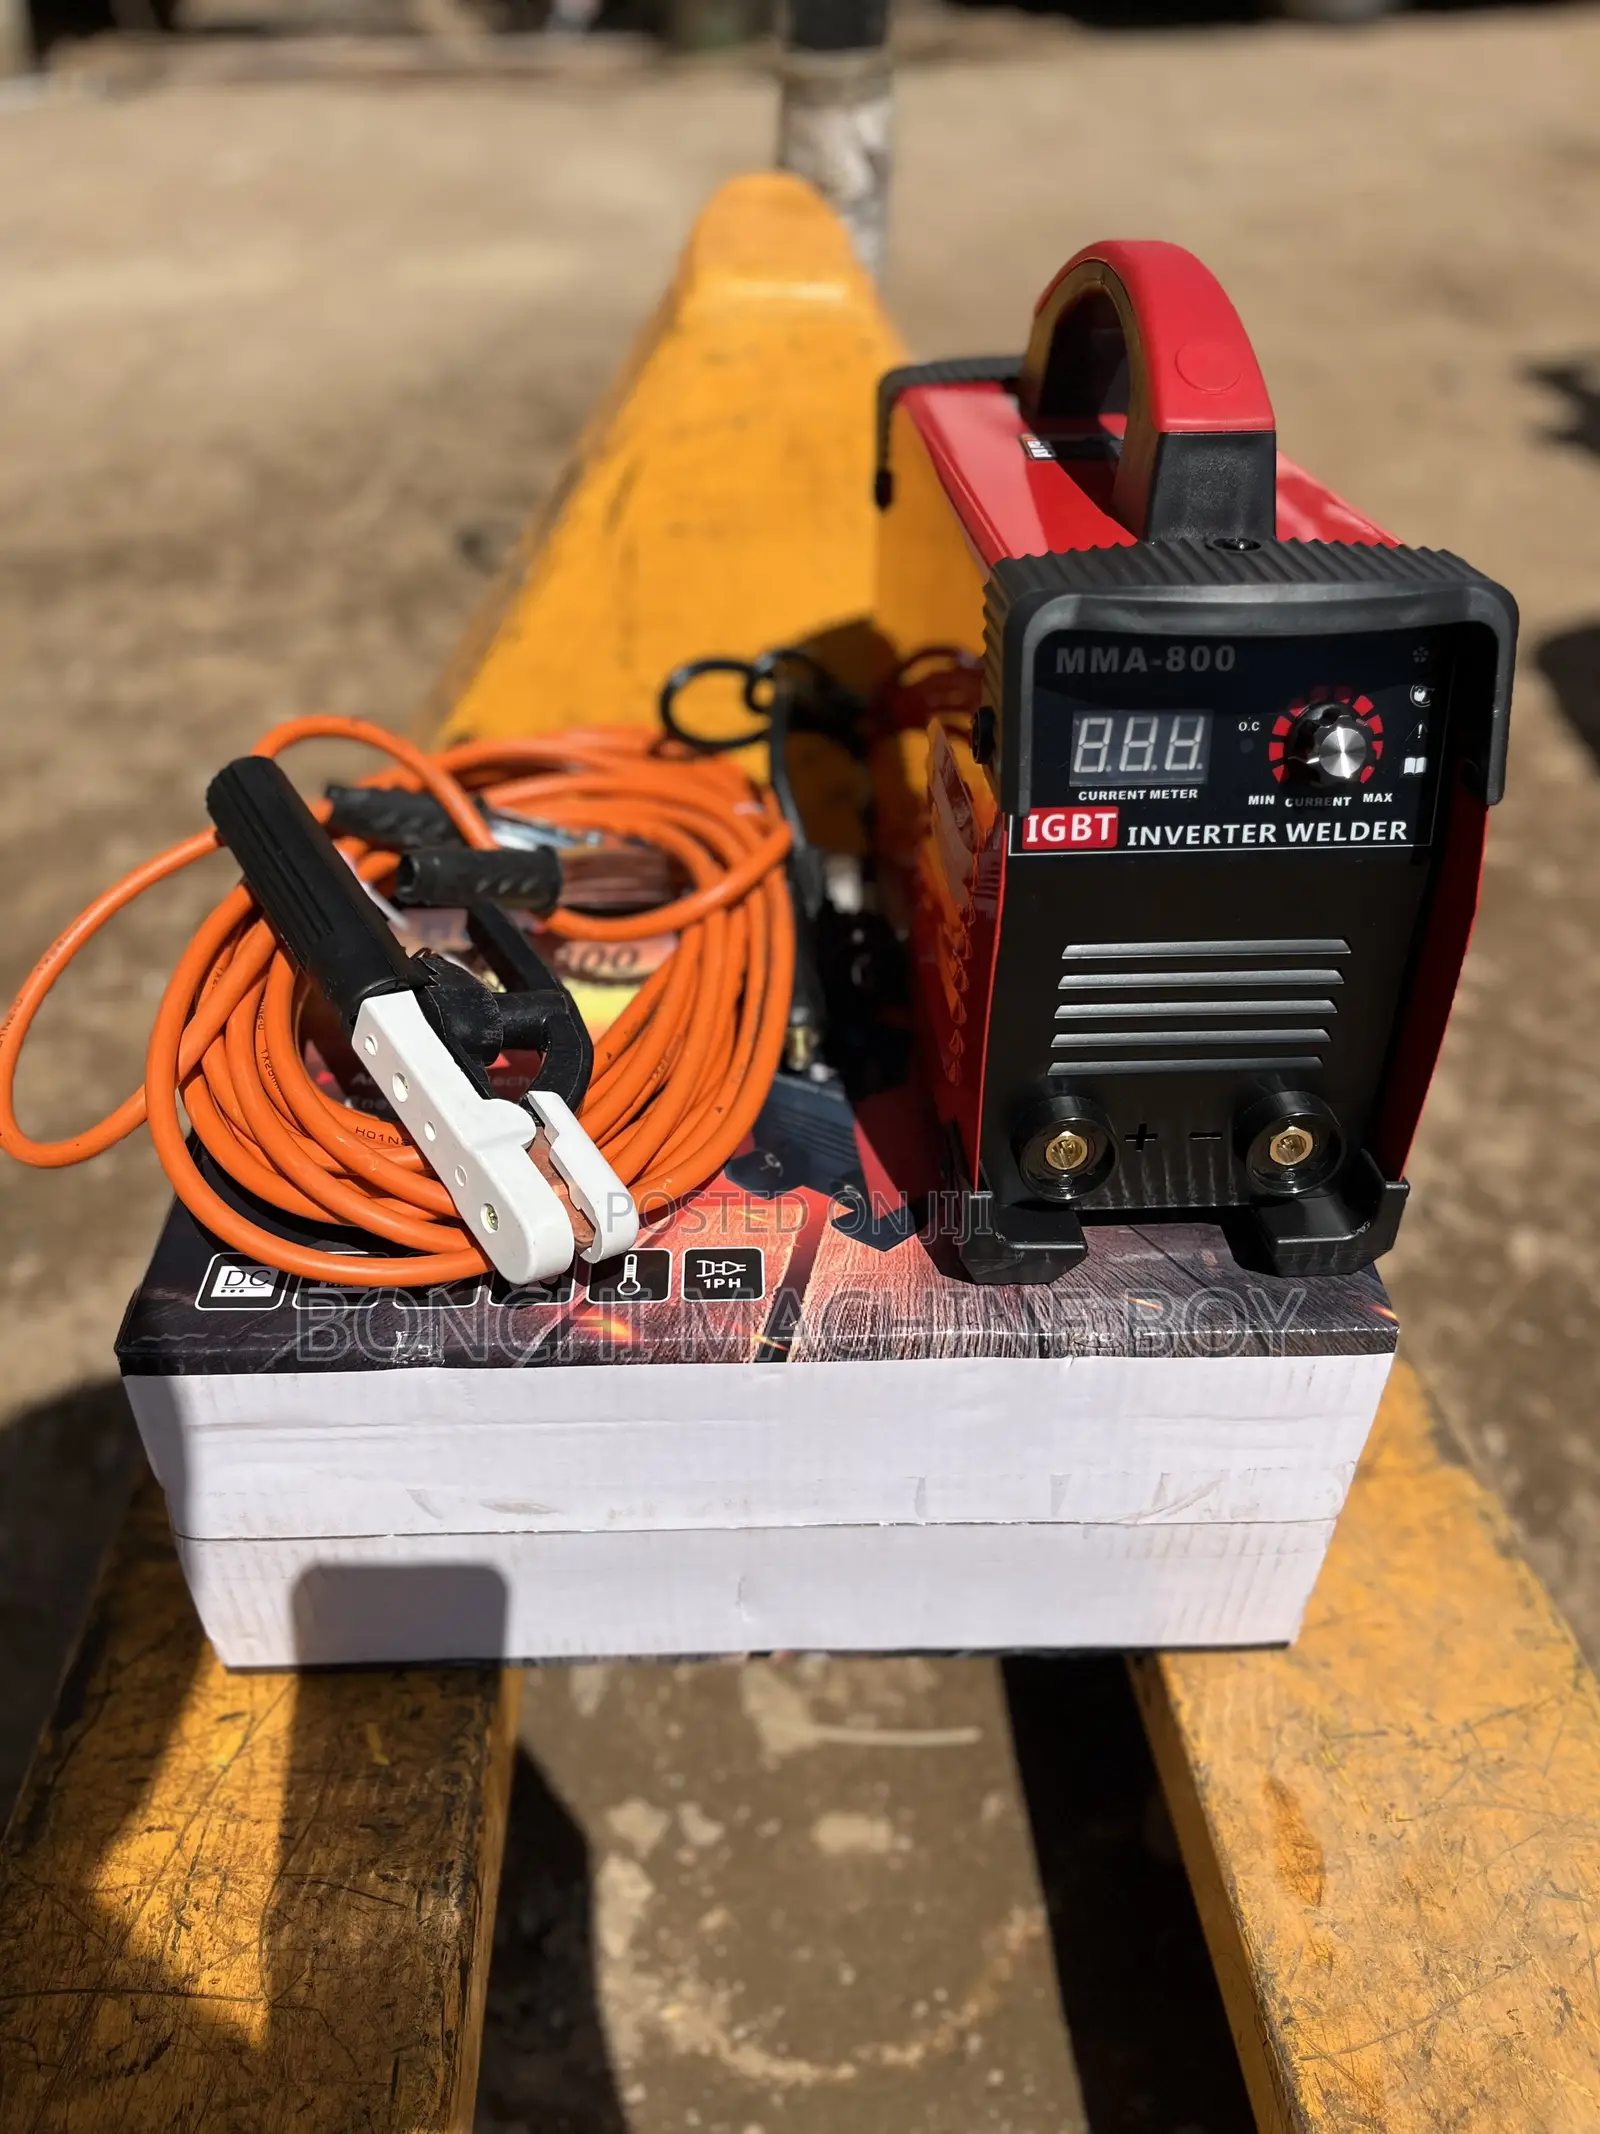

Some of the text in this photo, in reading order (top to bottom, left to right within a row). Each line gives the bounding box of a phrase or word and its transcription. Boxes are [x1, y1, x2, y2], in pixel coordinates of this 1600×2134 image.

[1056, 645, 1236, 673] MMA-800
[1078, 788, 1199, 801] CURRENT METER
[1248, 794, 1275, 806] MIN
[1363, 792, 1394, 804] MAX
[1026, 812, 1408, 847] IGBT INVERTER WELDER
[224, 1269, 271, 1286] DC
[703, 1278, 741, 1289] 1PH
